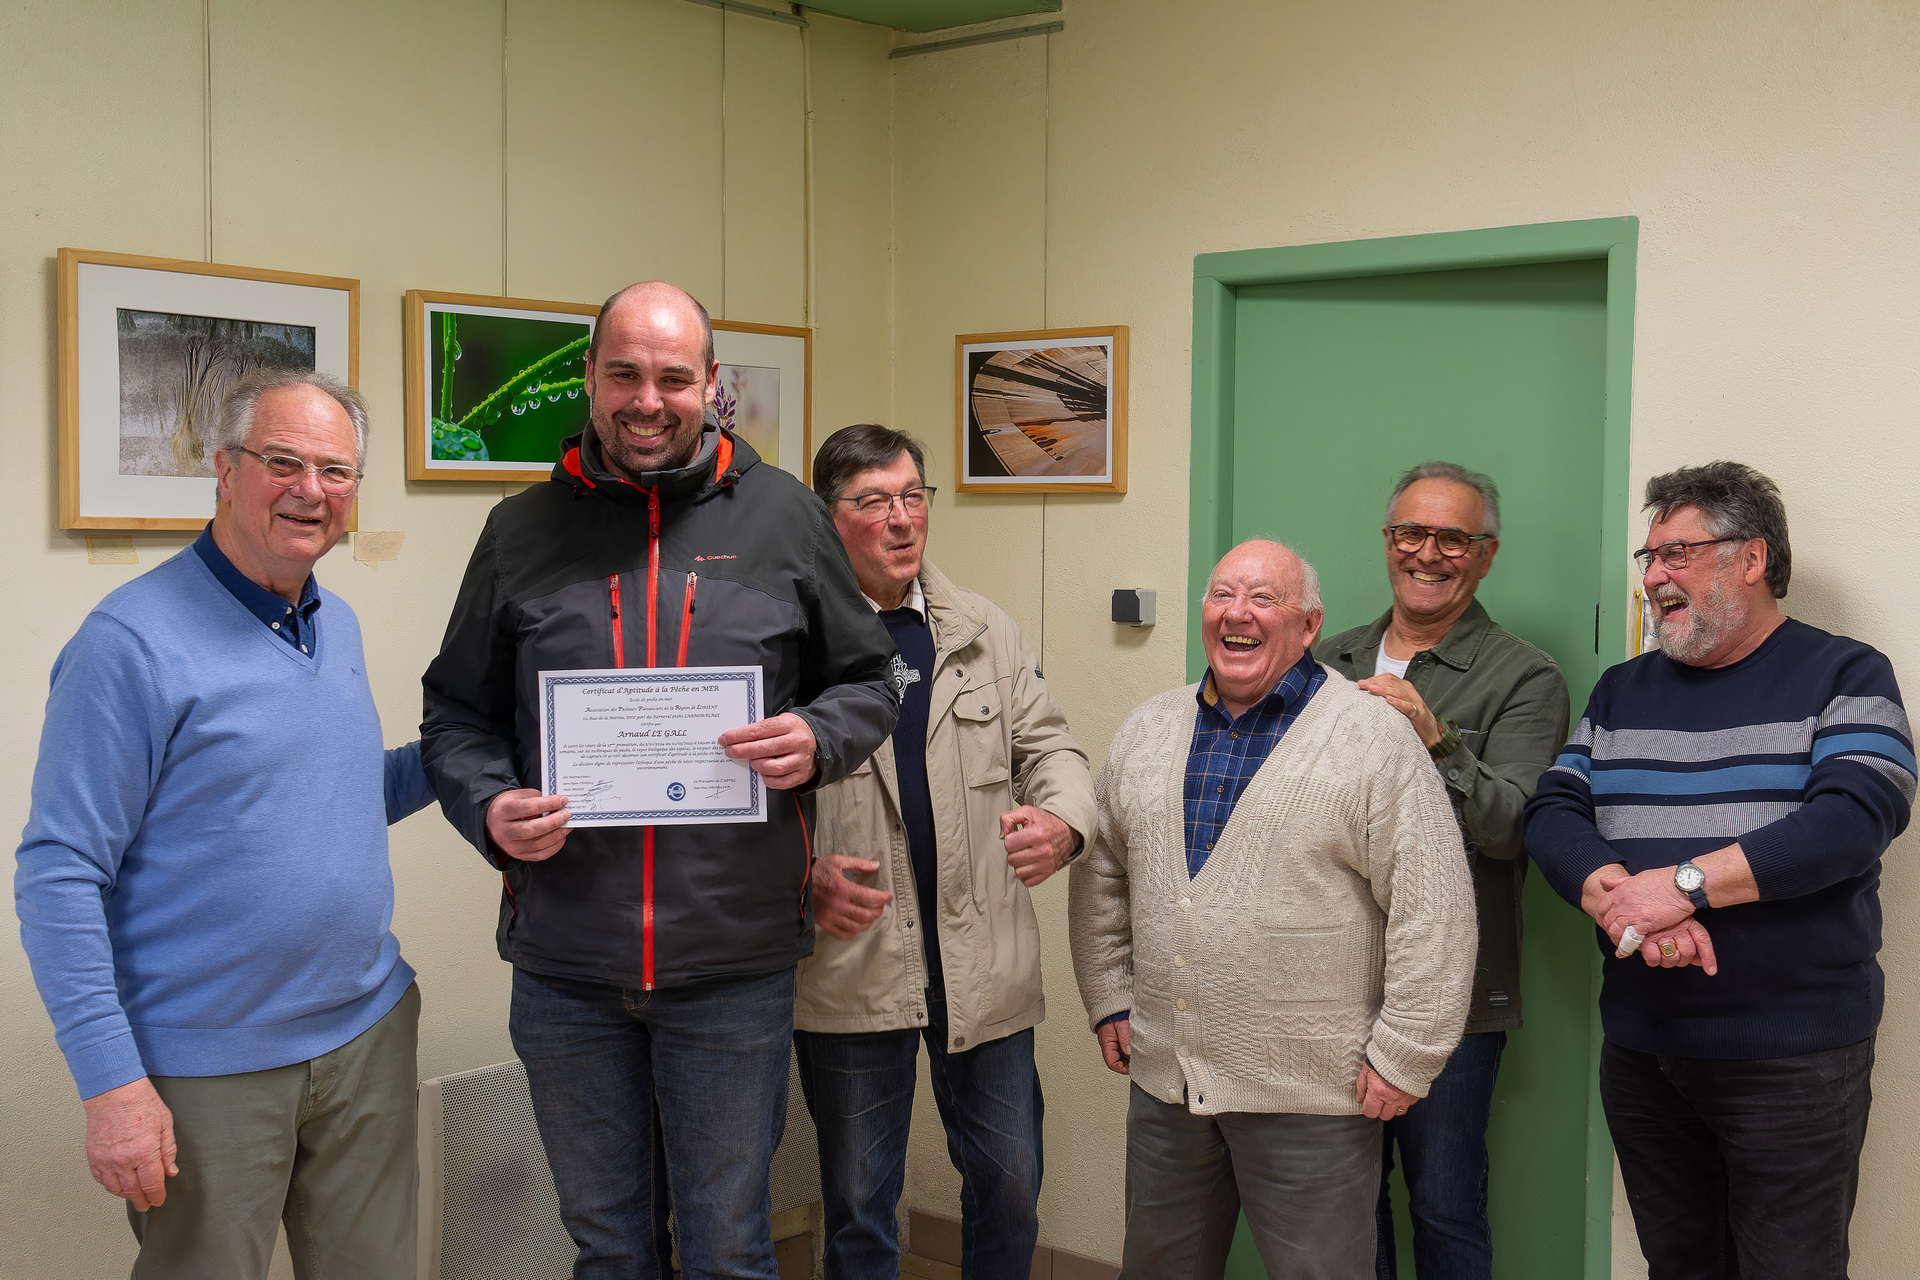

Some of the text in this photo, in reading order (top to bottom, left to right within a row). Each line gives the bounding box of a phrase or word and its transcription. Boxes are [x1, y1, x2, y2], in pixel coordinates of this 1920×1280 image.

[582, 688, 615, 696] Certificat
[617, 686, 653, 695] d'Aptitude
[664, 730, 688, 738] GALL
